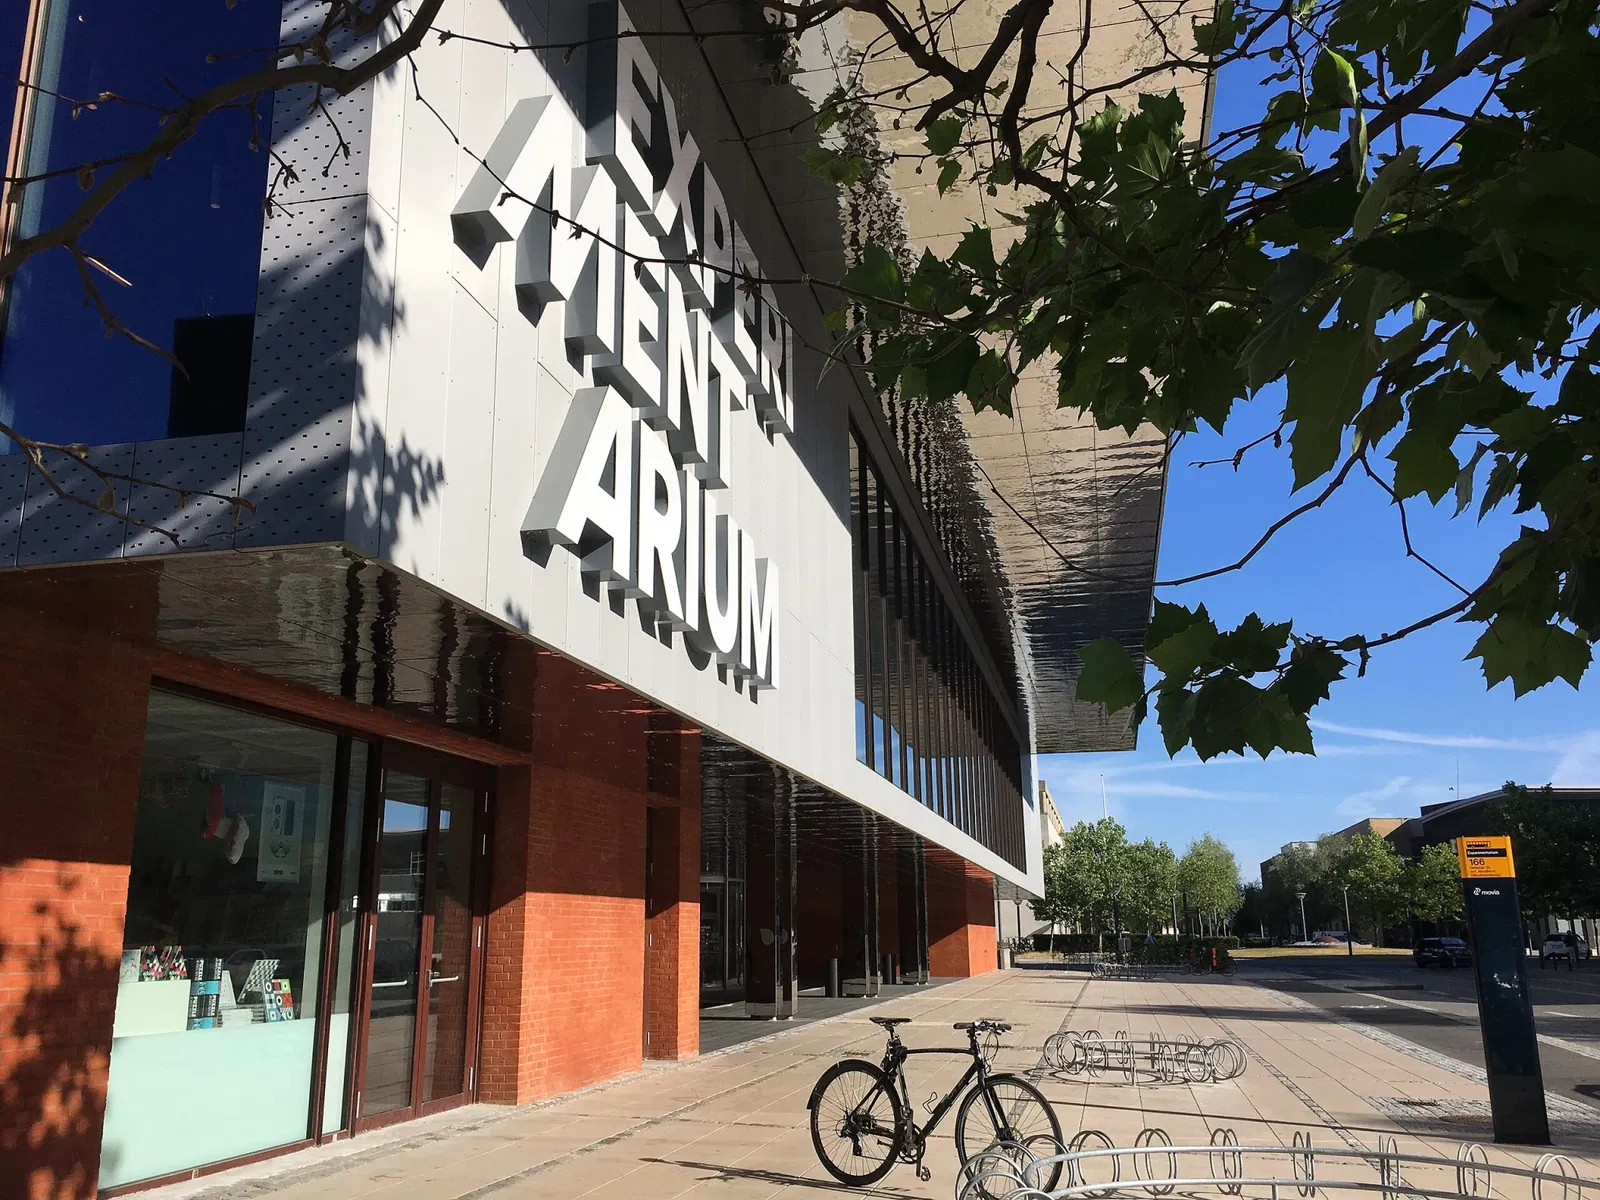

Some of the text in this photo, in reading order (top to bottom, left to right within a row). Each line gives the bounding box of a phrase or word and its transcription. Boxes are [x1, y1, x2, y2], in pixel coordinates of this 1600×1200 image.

[484, 95, 748, 489] MENT
[612, 2, 794, 434] EXPERI
[550, 386, 780, 690] ARIUM
[1469, 858, 1485, 866] 166
